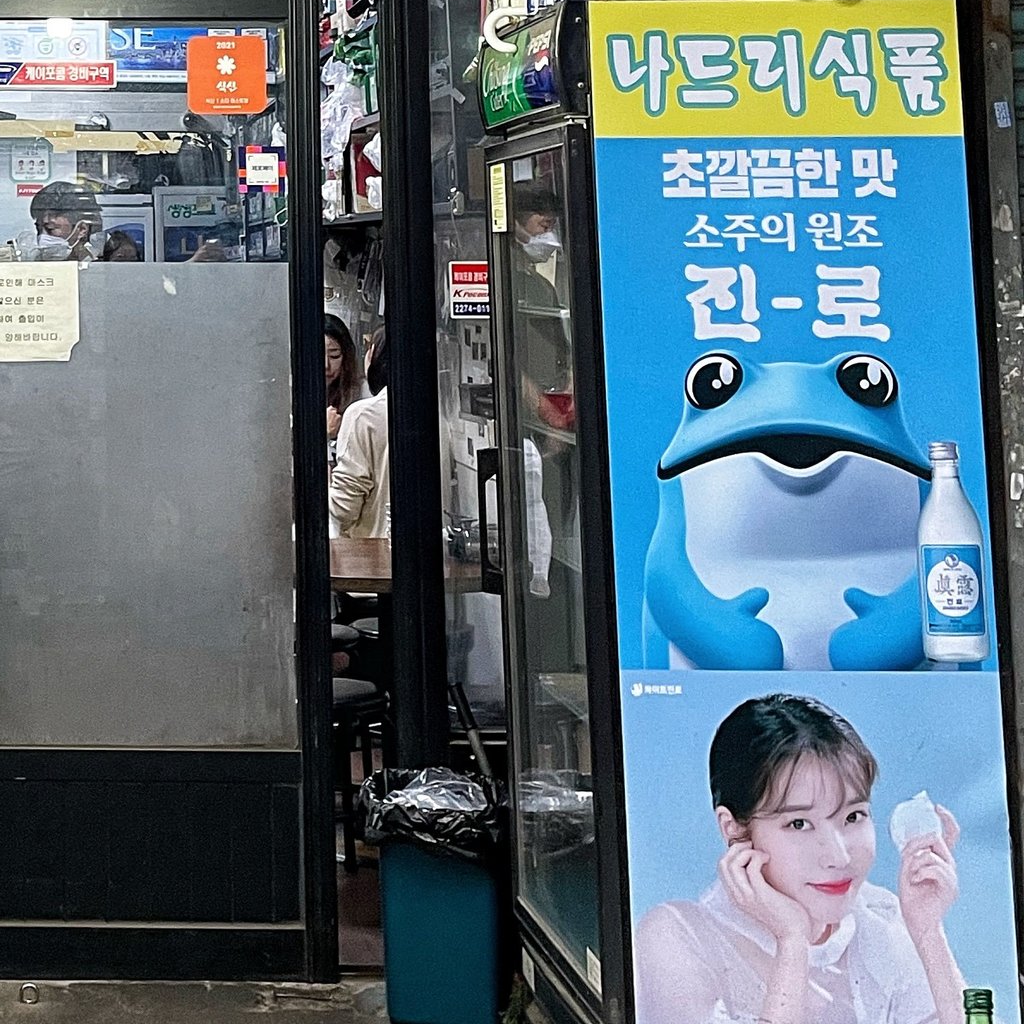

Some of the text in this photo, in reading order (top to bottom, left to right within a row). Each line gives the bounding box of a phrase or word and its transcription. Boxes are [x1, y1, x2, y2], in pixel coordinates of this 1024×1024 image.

[216, 41, 236, 49] 2021
[69, 66, 110, 81] 경비구역
[606, 27, 948, 118] 나드리식품
[662, 147, 898, 198] 초깔끔한 맛
[684, 213, 884, 252] 소주의 원조
[28, 278, 55, 287] 마스크
[27, 296, 45, 305] 분은
[684, 263, 891, 343] 진-로
